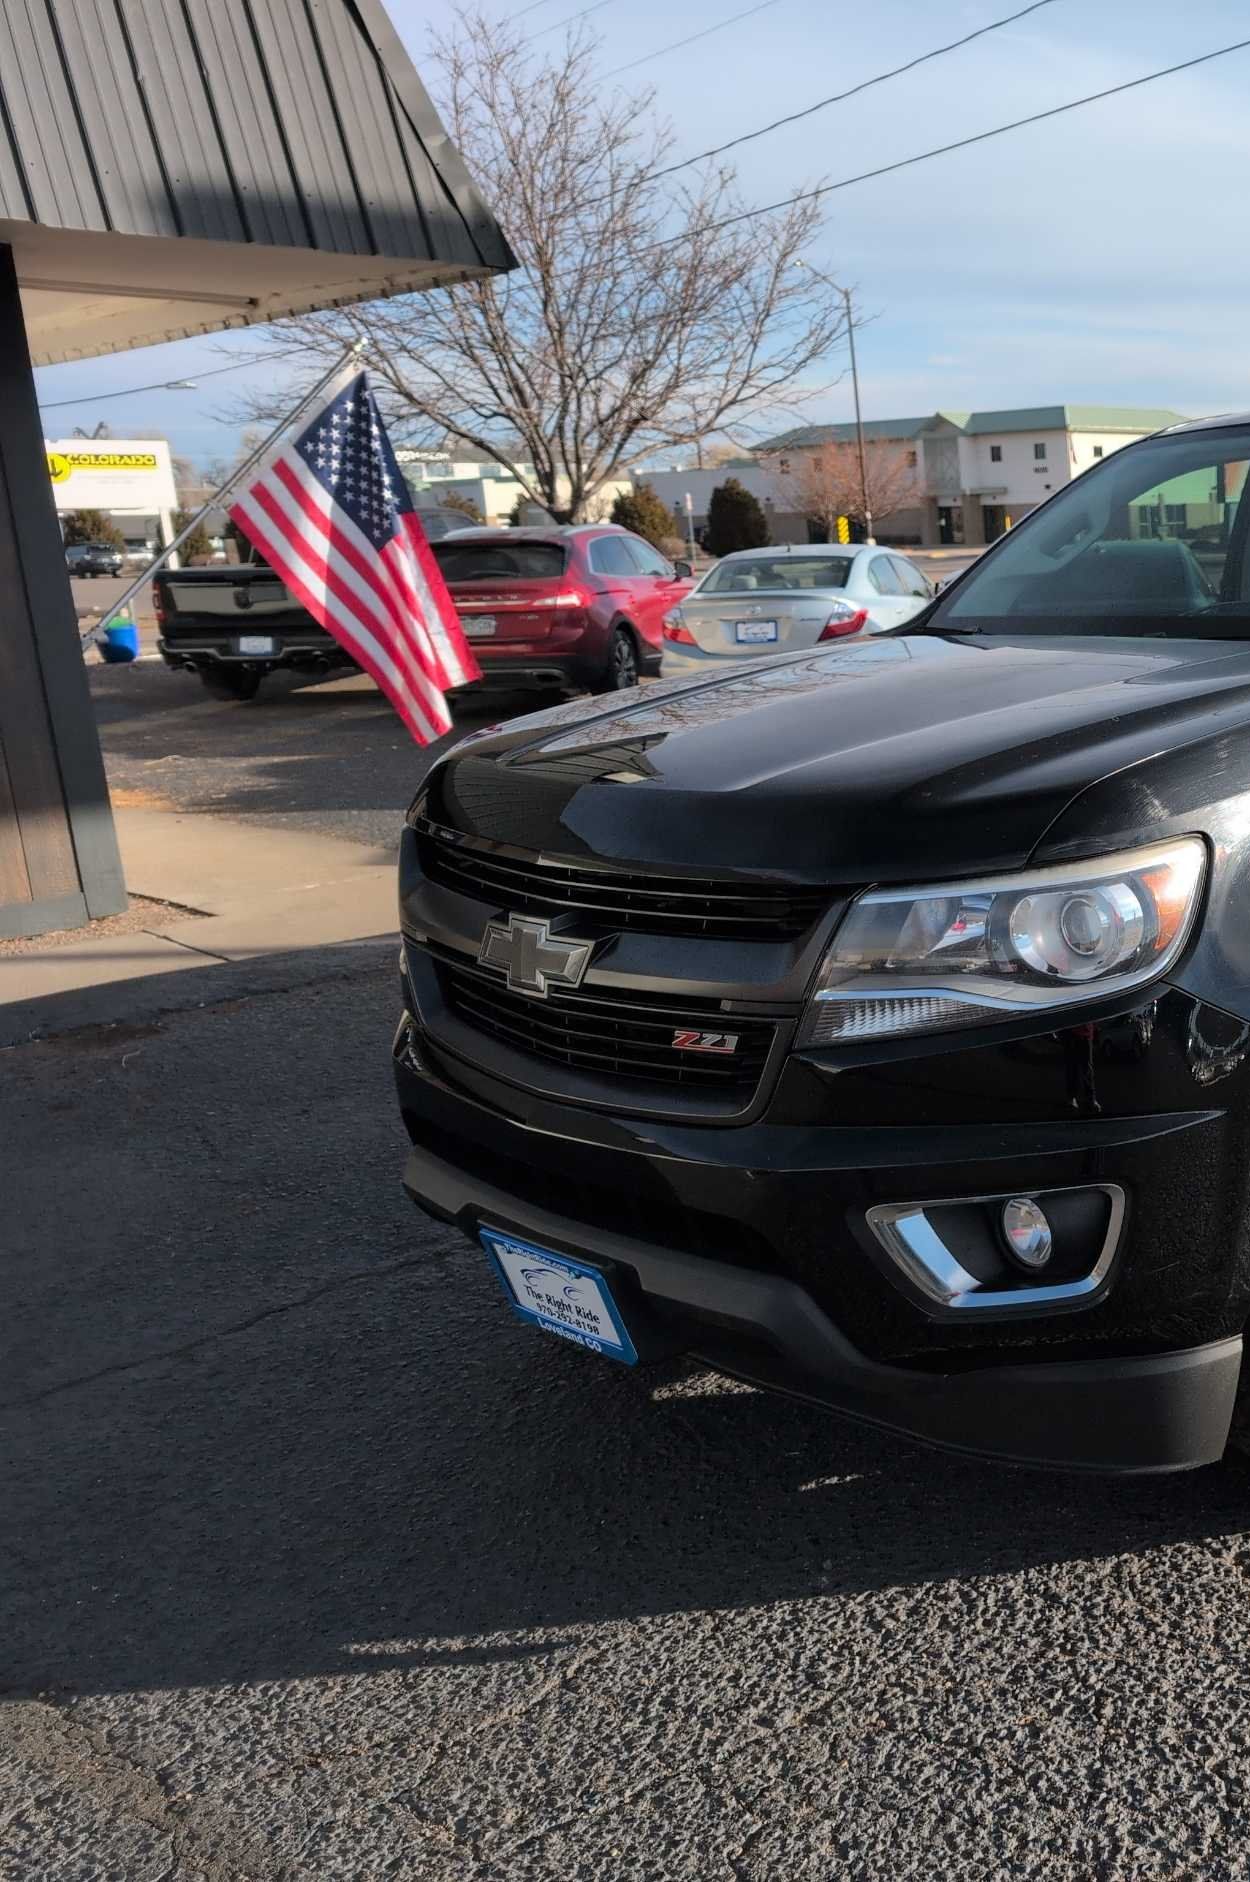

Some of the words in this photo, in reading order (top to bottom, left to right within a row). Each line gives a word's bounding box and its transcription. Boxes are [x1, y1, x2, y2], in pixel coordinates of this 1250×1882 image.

[67, 454, 155, 466] COLORADO
[671, 1030, 738, 1053] Z71
[524, 1285, 545, 1302] The
[546, 1294, 572, 1314] Right
[576, 1306, 601, 1325] Ride
[537, 1303, 600, 1335] 970-292-8198
[537, 1317, 584, 1346] Loveland
[584, 1337, 602, 1352] CO
